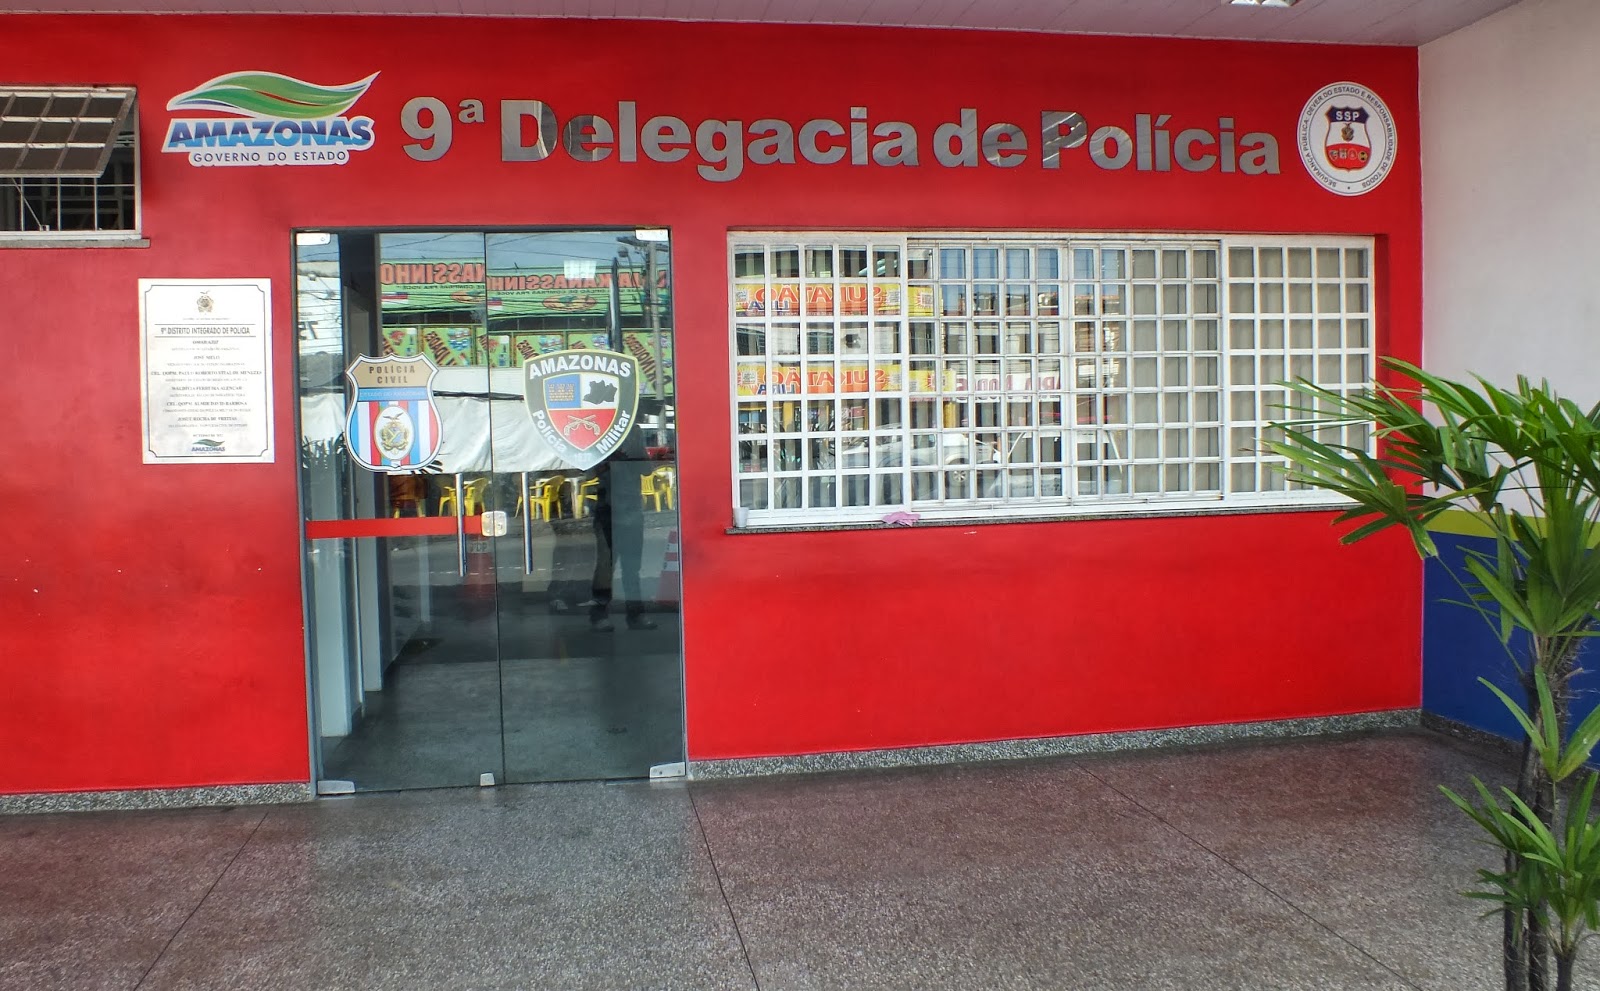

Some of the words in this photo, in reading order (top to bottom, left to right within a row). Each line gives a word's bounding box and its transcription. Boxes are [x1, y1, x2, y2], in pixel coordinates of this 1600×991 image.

[1323, 90, 1333, 98] DO
[1333, 86, 1360, 95] ESTADO
[1307, 95, 1323, 116] DEVER
[1335, 110, 1360, 121] SSP
[168, 119, 372, 148] AMAZONAS
[400, 96, 485, 162] 9ª
[500, 98, 920, 182] Delegacia
[932, 108, 1028, 168] de
[1041, 109, 1281, 175] Polícia
[193, 151, 261, 163] GOVERNO
[268, 151, 287, 163] DO
[294, 150, 347, 162] ESTADO
[1381, 162, 1388, 172] DE
[1362, 172, 1382, 189] TODOS
[167, 327, 190, 335] DISTRITO
[191, 327, 221, 335] INTEGRADO
[222, 327, 229, 335] DE
[369, 364, 416, 374] POLÍCIA
[529, 354, 632, 380] AMAZONAS
[376, 375, 408, 384] CIVIL
[532, 409, 568, 453] Polícia
[595, 409, 631, 454] Militar
